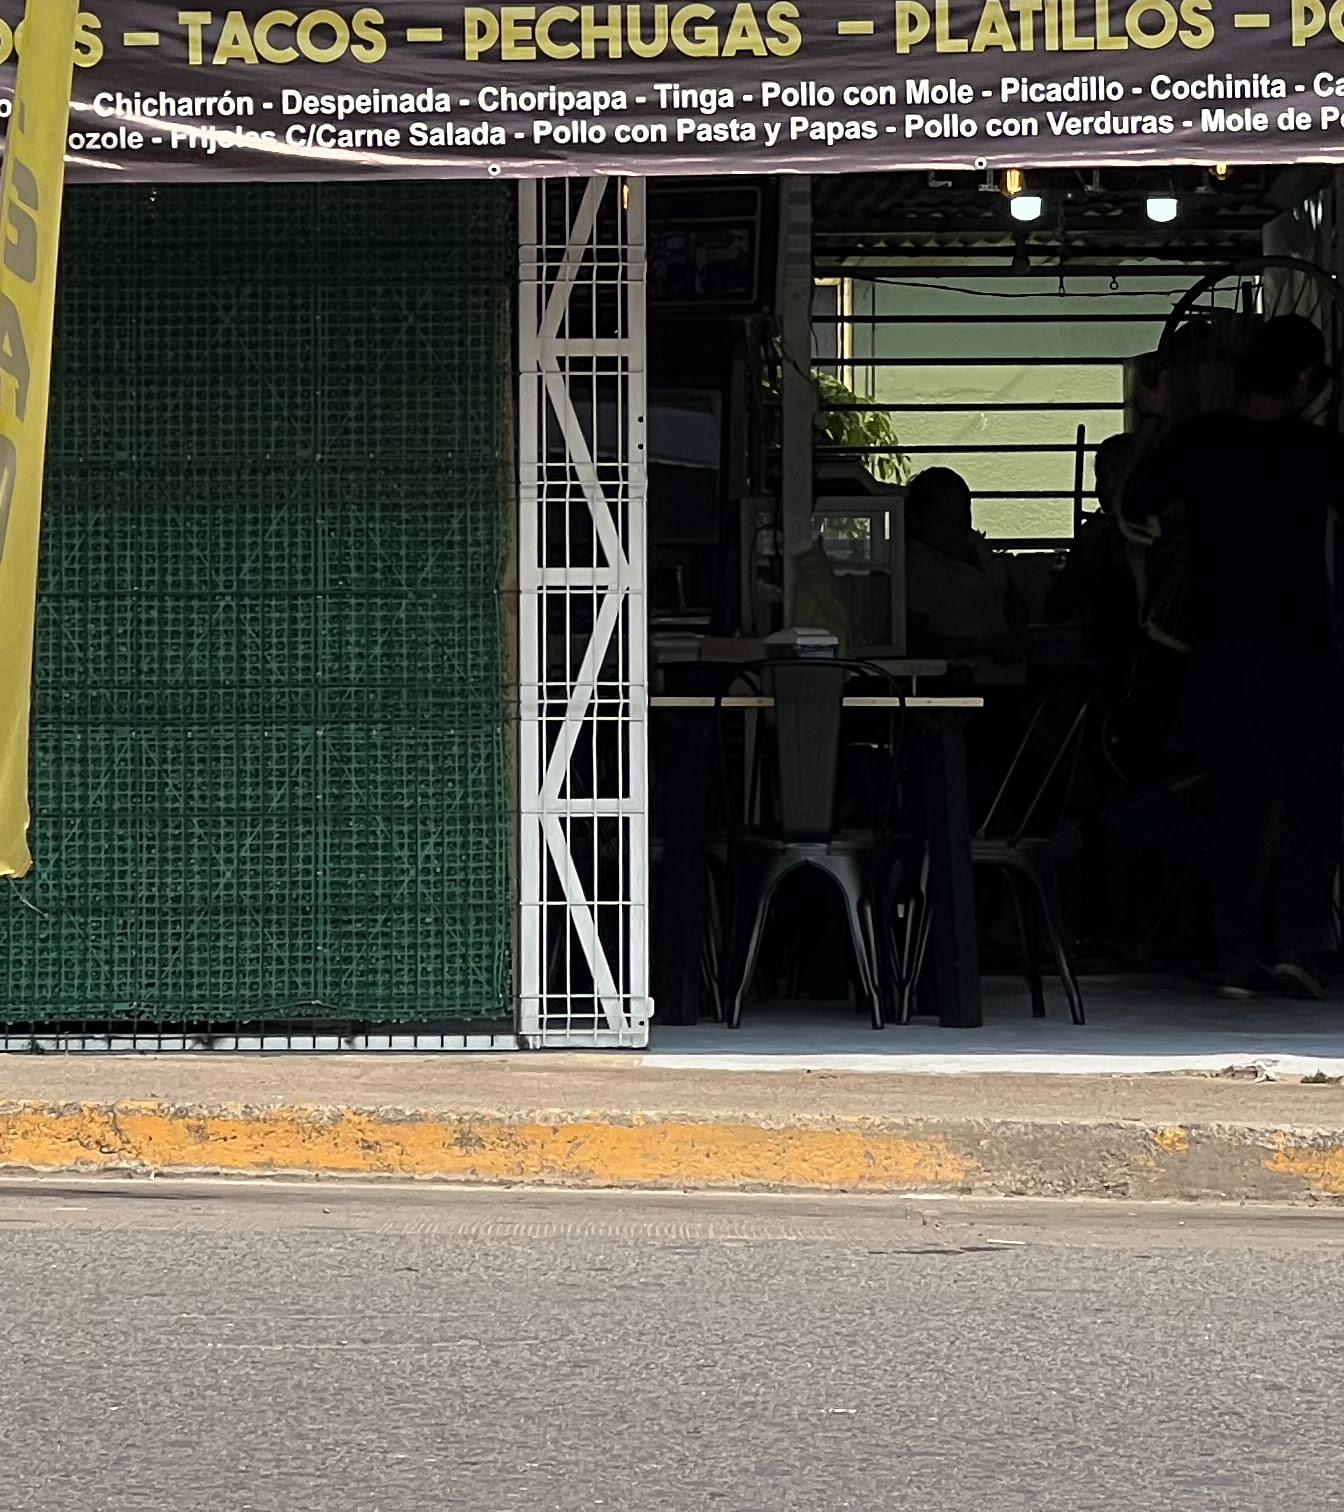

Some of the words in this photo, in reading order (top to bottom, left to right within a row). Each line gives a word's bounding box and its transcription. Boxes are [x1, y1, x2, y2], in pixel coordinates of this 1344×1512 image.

[179, 10, 387, 65] TACOS
[465, 2, 802, 61] PECHUGAS
[93, 88, 251, 115] Chicharrón
[282, 85, 451, 118] Despeinada
[478, 83, 626, 116] Choripapa
[655, 81, 734, 114] Tinga
[761, 80, 834, 107] Pollo
[842, 86, 897, 106] con
[907, 78, 973, 105] Mole
[1000, 76, 1123, 103] Picadillo
[1151, 74, 1286, 101] Cochinita
[68, 124, 144, 149] ozole
[286, 120, 399, 145] C/Carne
[408, 119, 505, 144] Salada
[533, 117, 605, 142] Pollo
[613, 121, 667, 141] con
[677, 115, 755, 140] Pasta
[764, 119, 778, 144] y
[790, 113, 877, 143] Papas
[905, 111, 976, 136] Pollo
[985, 115, 1038, 135] con
[1046, 109, 1174, 134] Verduras
[1201, 107, 1268, 132] Mole
[1277, 106, 1311, 131] de
